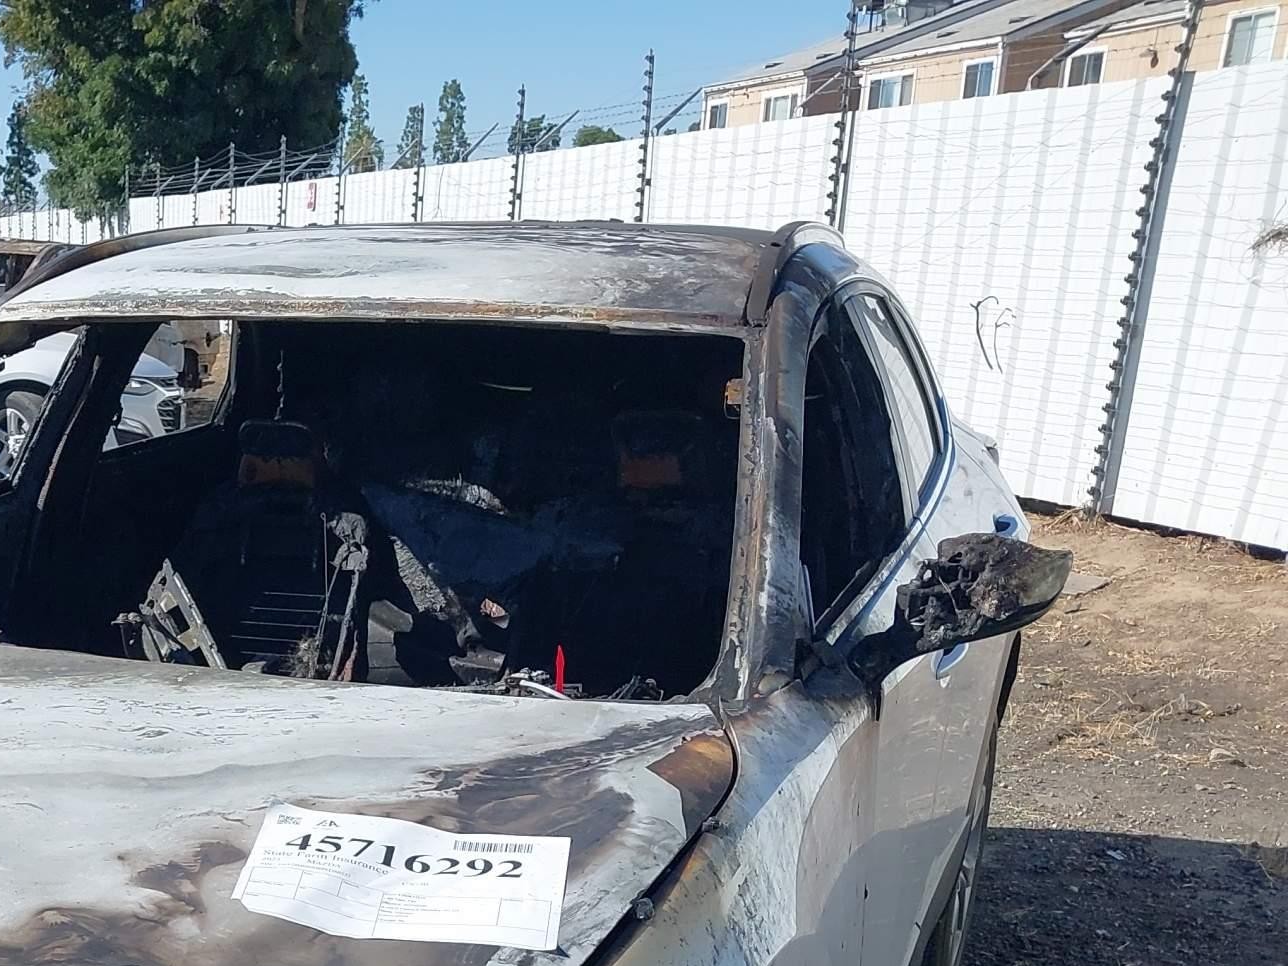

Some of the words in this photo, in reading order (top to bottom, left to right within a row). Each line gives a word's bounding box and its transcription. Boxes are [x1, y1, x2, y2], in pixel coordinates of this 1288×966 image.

[263, 849, 294, 857] State
[297, 851, 328, 860] Farm
[332, 853, 389, 875] Insurance
[285, 833, 523, 878] 45716292
